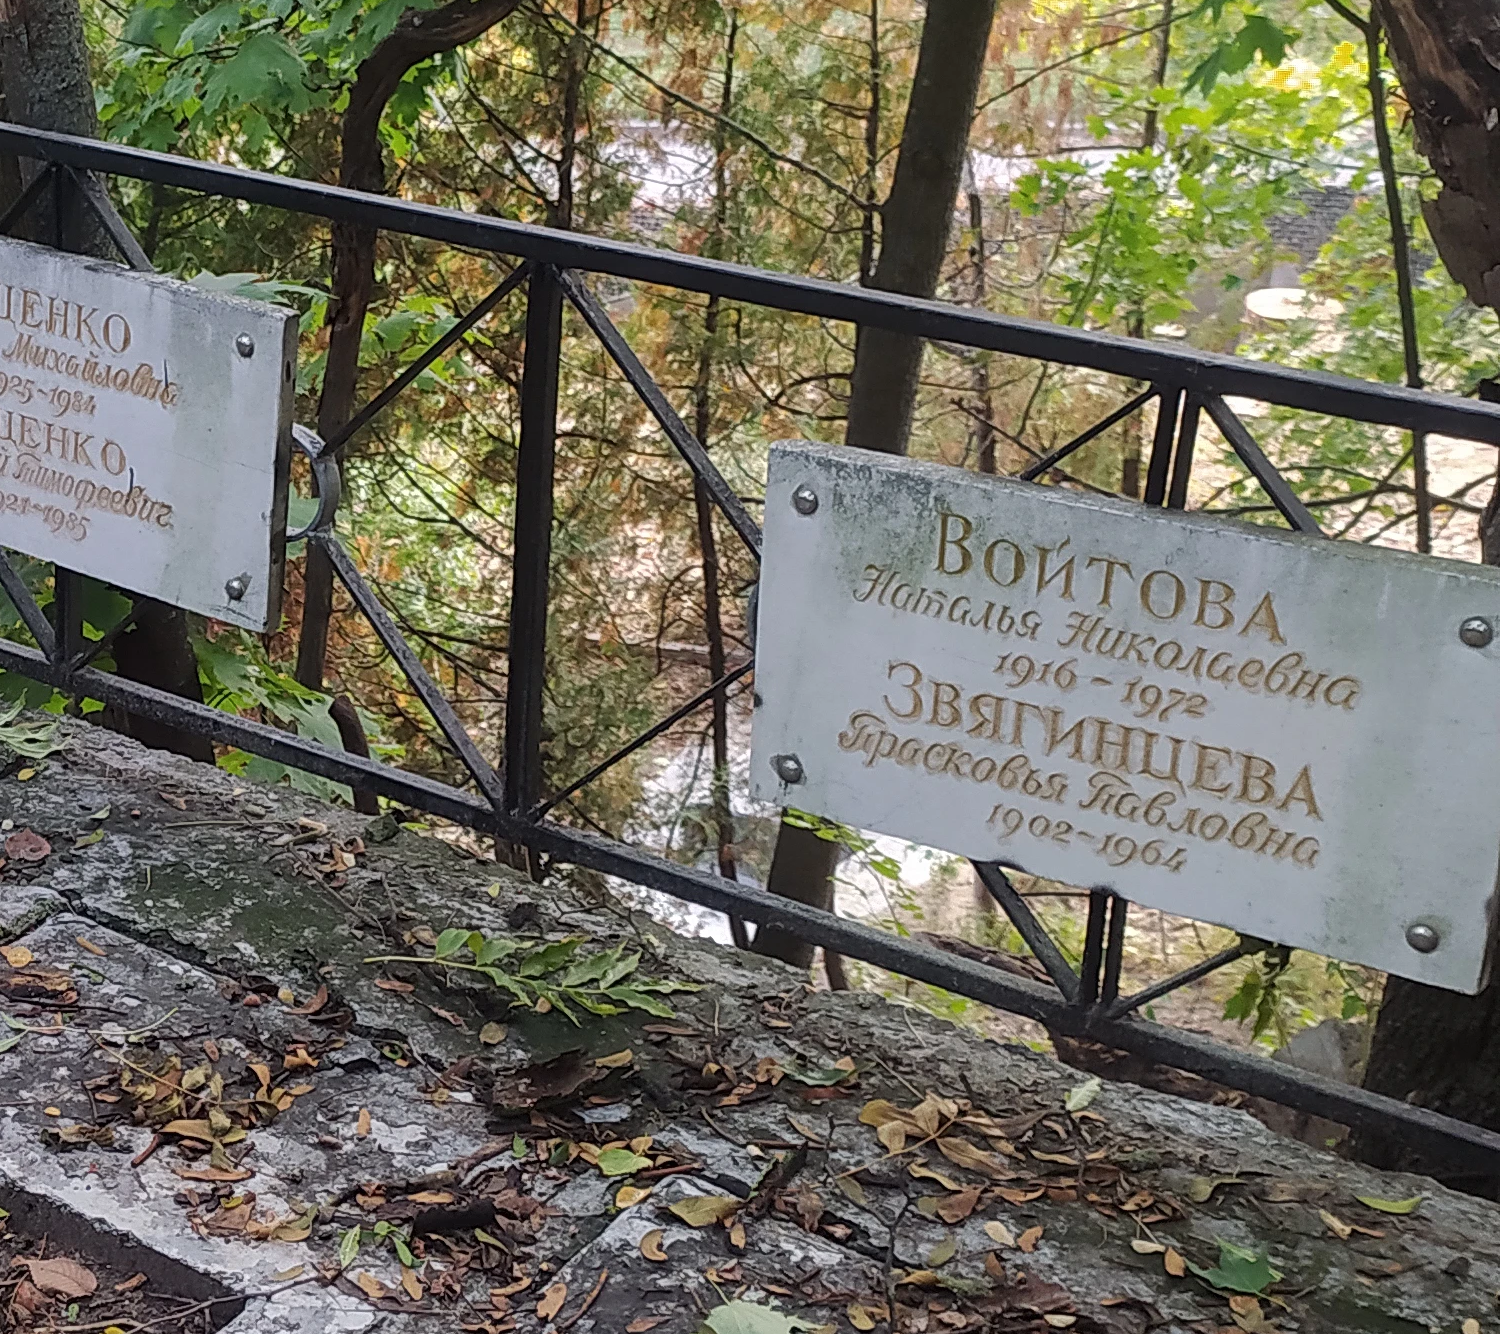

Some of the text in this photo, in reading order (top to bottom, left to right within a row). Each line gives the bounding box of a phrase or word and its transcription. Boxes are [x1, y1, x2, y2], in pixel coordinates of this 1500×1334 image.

[2, 333, 178, 408] Михайловна
[12, 452, 174, 529] Тимофеевич
[853, 564, 1362, 711] Наталья Николаевна
[934, 511, 1286, 645] ВОЙТОВА
[838, 709, 1321, 869] Прасковья Павловна
[882, 661, 1323, 821] ЗВЯГИНЦЕВА
